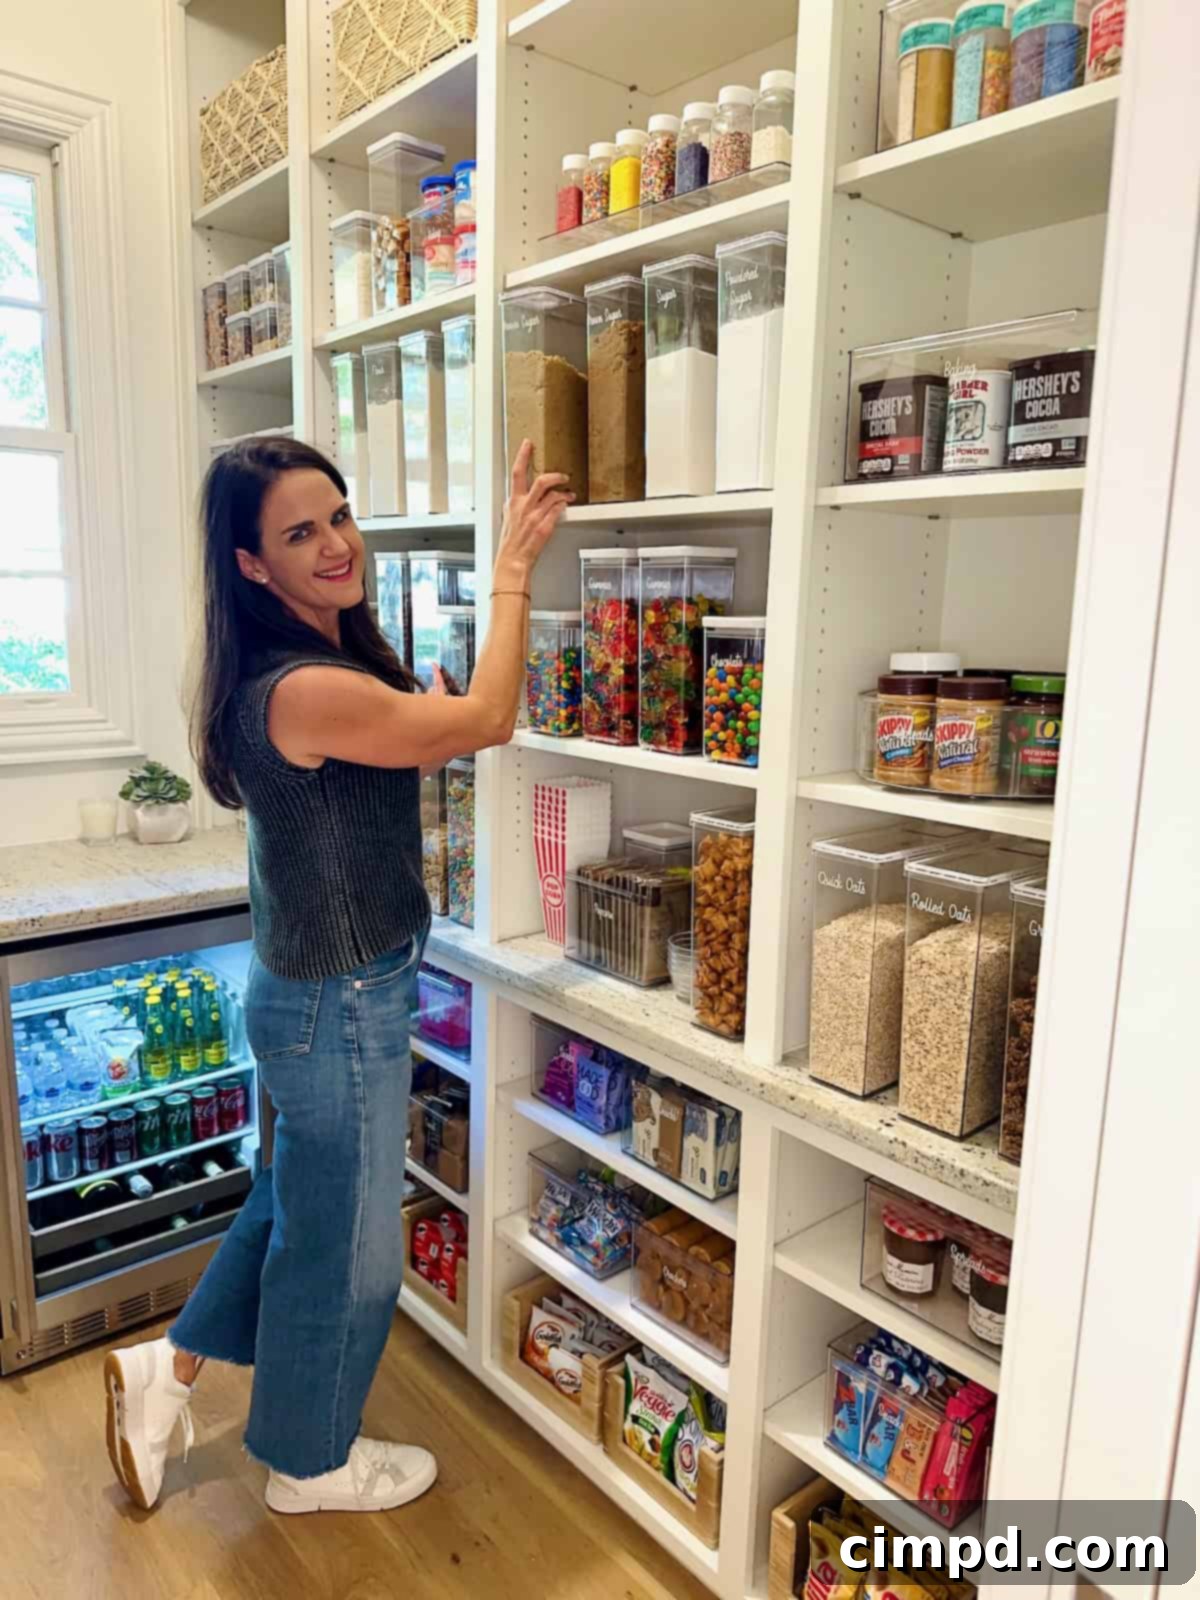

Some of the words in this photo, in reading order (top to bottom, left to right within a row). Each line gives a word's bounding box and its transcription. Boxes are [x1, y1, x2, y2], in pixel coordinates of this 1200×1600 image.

[656, 288, 677, 309] Sugar
[730, 289, 753, 311] Sugar
[944, 358, 976, 378] Baking
[1013, 371, 1081, 402] HERSHEY'S
[862, 395, 913, 420] HERSHEY'S
[1025, 398, 1061, 419] COCOA
[869, 417, 897, 437] COCOA
[878, 717, 912, 737] SKIPPY
[935, 722, 975, 745] SKIPPY
[818, 871, 843, 888] Quick
[846, 877, 866, 895] Oats
[910, 892, 946, 916] Rolled
[949, 904, 972, 923] Oats
[633, 1377, 676, 1422] Veggie
